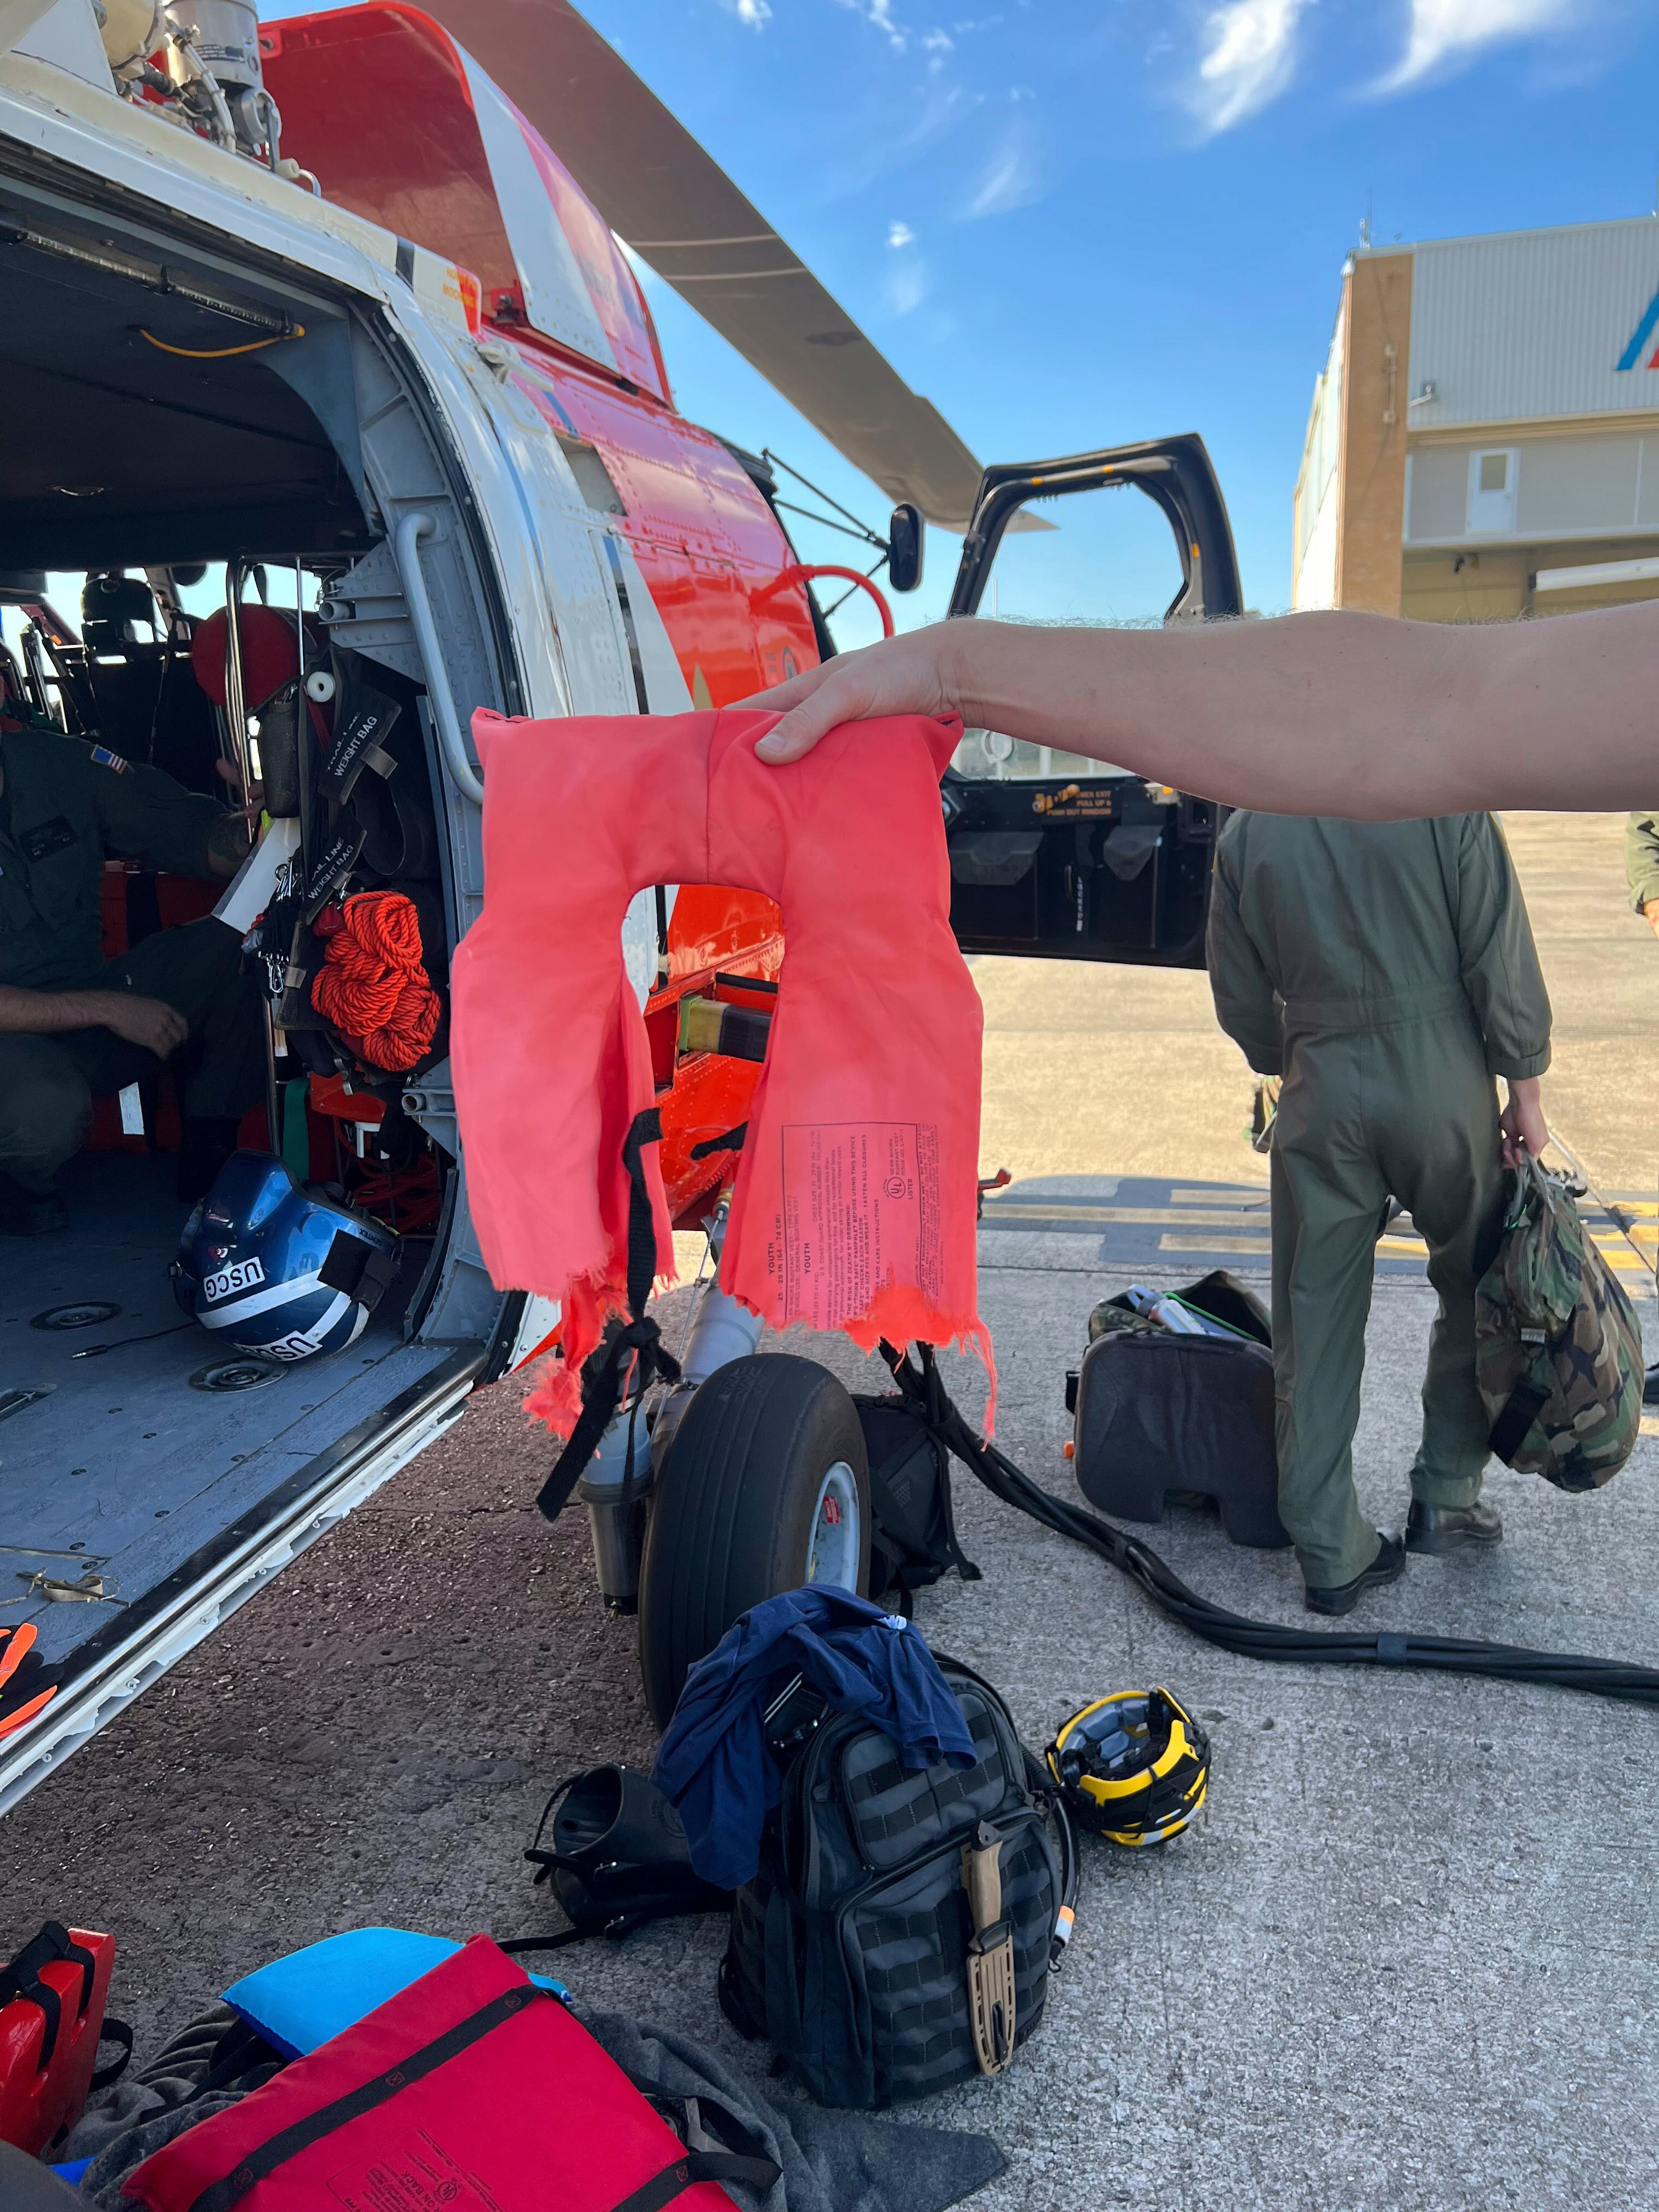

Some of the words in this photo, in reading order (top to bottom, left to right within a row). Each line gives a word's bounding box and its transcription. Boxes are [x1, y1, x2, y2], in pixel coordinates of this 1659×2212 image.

[334, 737, 361, 776] WEIGHT
[357, 716, 377, 739] BAG
[325, 837, 344, 861] LINE
[308, 865, 337, 899] WEIGHT
[336, 845, 354, 866] BAG
[920, 1166, 923, 1175] DO
[890, 1182, 901, 1194] UL
[776, 1232, 781, 1240] 74
[847, 1242, 851, 1250] BY
[915, 1253, 918, 1262] OH
[205, 1262, 261, 1298] USCG
[778, 1275, 783, 1284] 29
[778, 1293, 783, 1301] 25
[400, 2170, 424, 2196] BACK
[422, 2193, 435, 2207] ON
